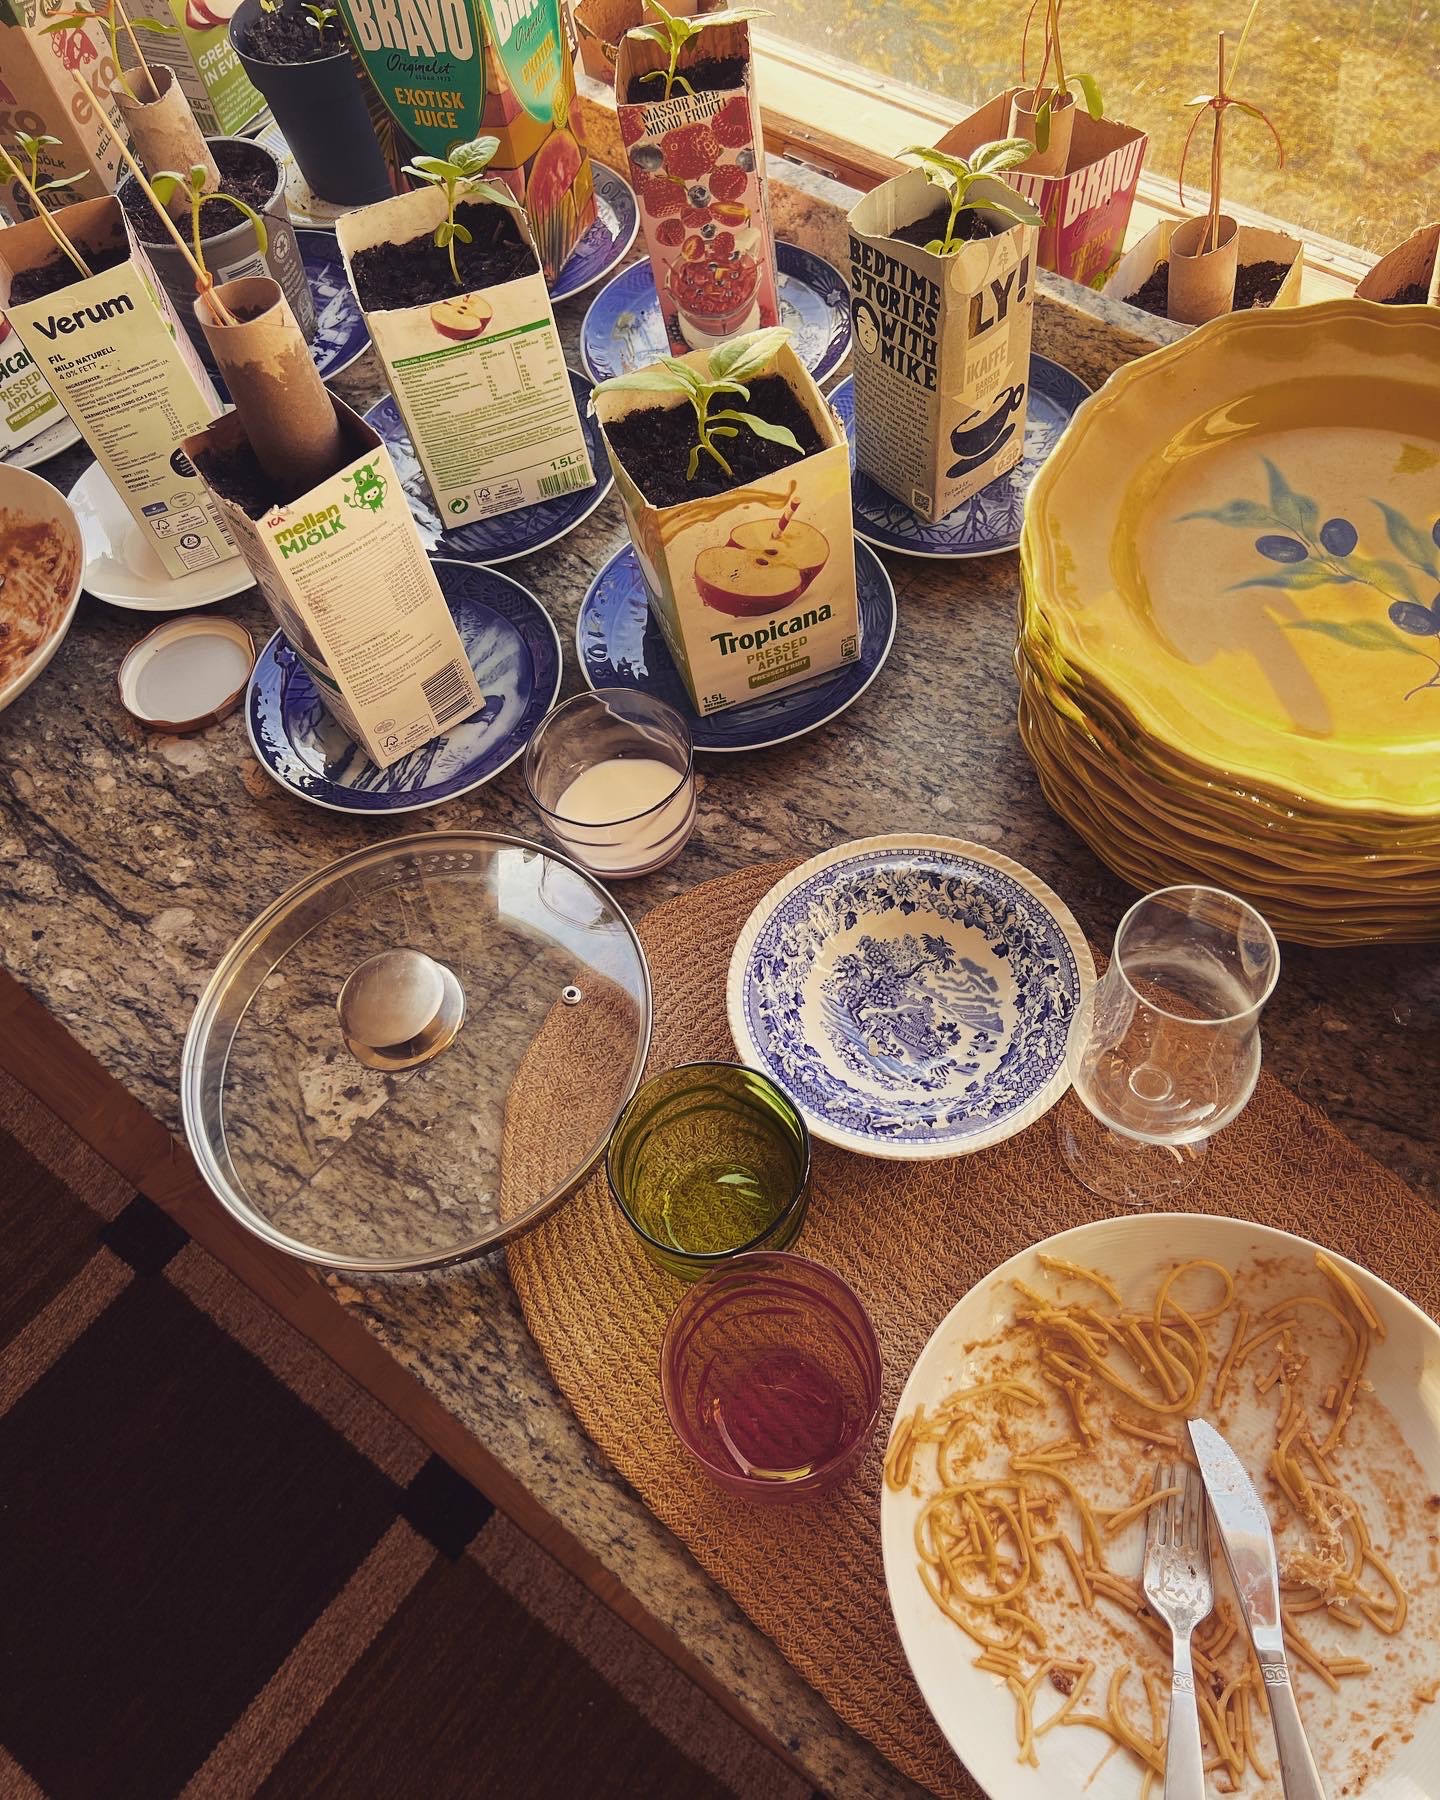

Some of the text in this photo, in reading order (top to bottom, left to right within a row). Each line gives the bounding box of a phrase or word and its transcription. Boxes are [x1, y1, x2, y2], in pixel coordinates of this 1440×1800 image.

[350, 0, 473, 61] BRAVO
[198, 38, 232, 70] GREA
[387, 54, 455, 78] Originalet
[204, 70, 218, 87] IN
[394, 87, 465, 109] EXOTISK
[640, 96, 689, 124] MASSOR
[414, 109, 458, 129] JUICE
[645, 115, 683, 137] MIXAD
[849, 234, 941, 312] BEDTIME
[851, 266, 938, 337] STORIES
[969, 254, 1029, 340] LY!
[33, 294, 135, 340] Verum
[880, 309, 938, 367] WITH
[48, 353, 66, 365] FIL
[54, 346, 116, 374] MILD NATURELL
[79, 362, 97, 374] FETT
[880, 338, 938, 392] MIKE
[0, 371, 42, 402] RESSED
[7, 385, 42, 412] APPLE
[550, 455, 577, 471] 1.5L
[266, 516, 286, 529] ICA
[274, 504, 340, 545] mellan
[279, 514, 347, 559] MJÖLK
[710, 604, 832, 656] Tropicana
[746, 636, 808, 664] PRESSED
[758, 651, 800, 671] APPLE
[702, 693, 727, 704] 1.5L
